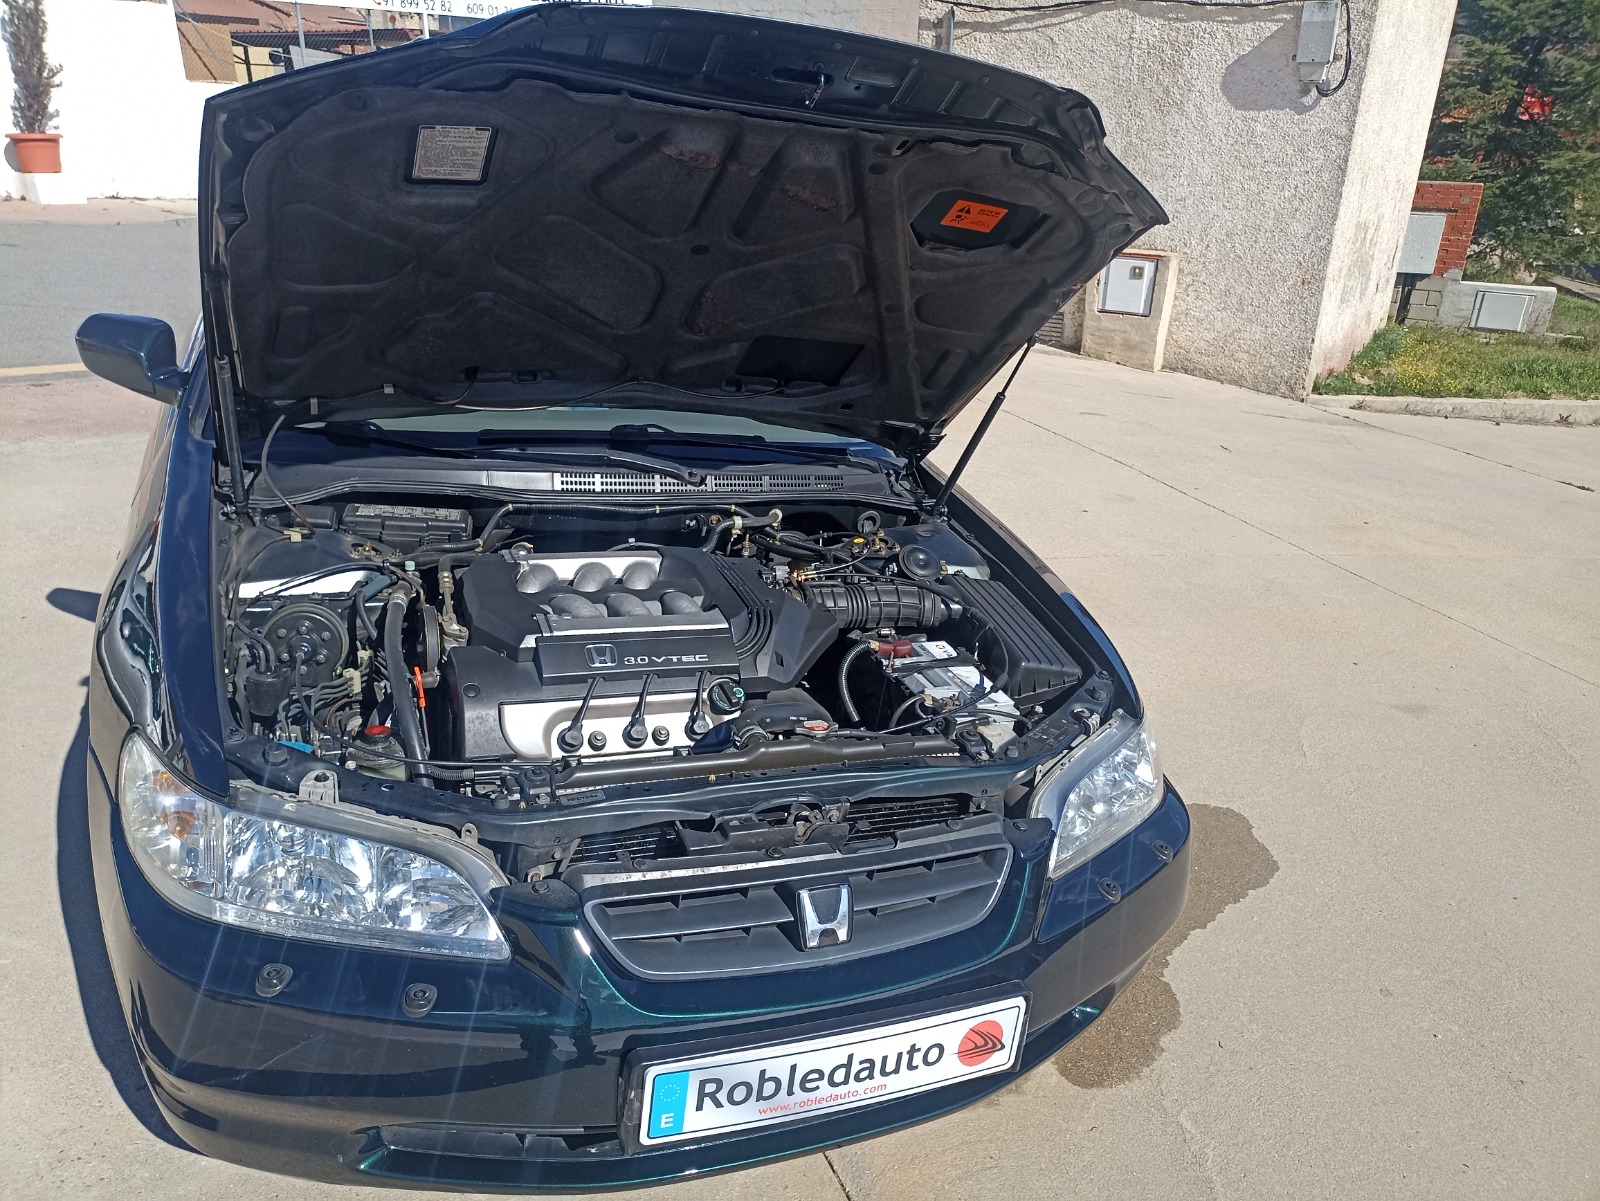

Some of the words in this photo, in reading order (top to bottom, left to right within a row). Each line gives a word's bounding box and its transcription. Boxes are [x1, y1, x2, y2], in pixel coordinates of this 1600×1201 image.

[424, 0, 436, 11] 52
[441, 0, 452, 12] 82
[467, 3, 484, 14] 609
[488, 5, 499, 16] 01
[624, 656, 649, 665] 3.0
[651, 654, 709, 663] VTEC
[695, 1042, 945, 1112] Robledauto
[757, 1083, 887, 1116] www.robledauto.com
[660, 1113, 674, 1129] E
